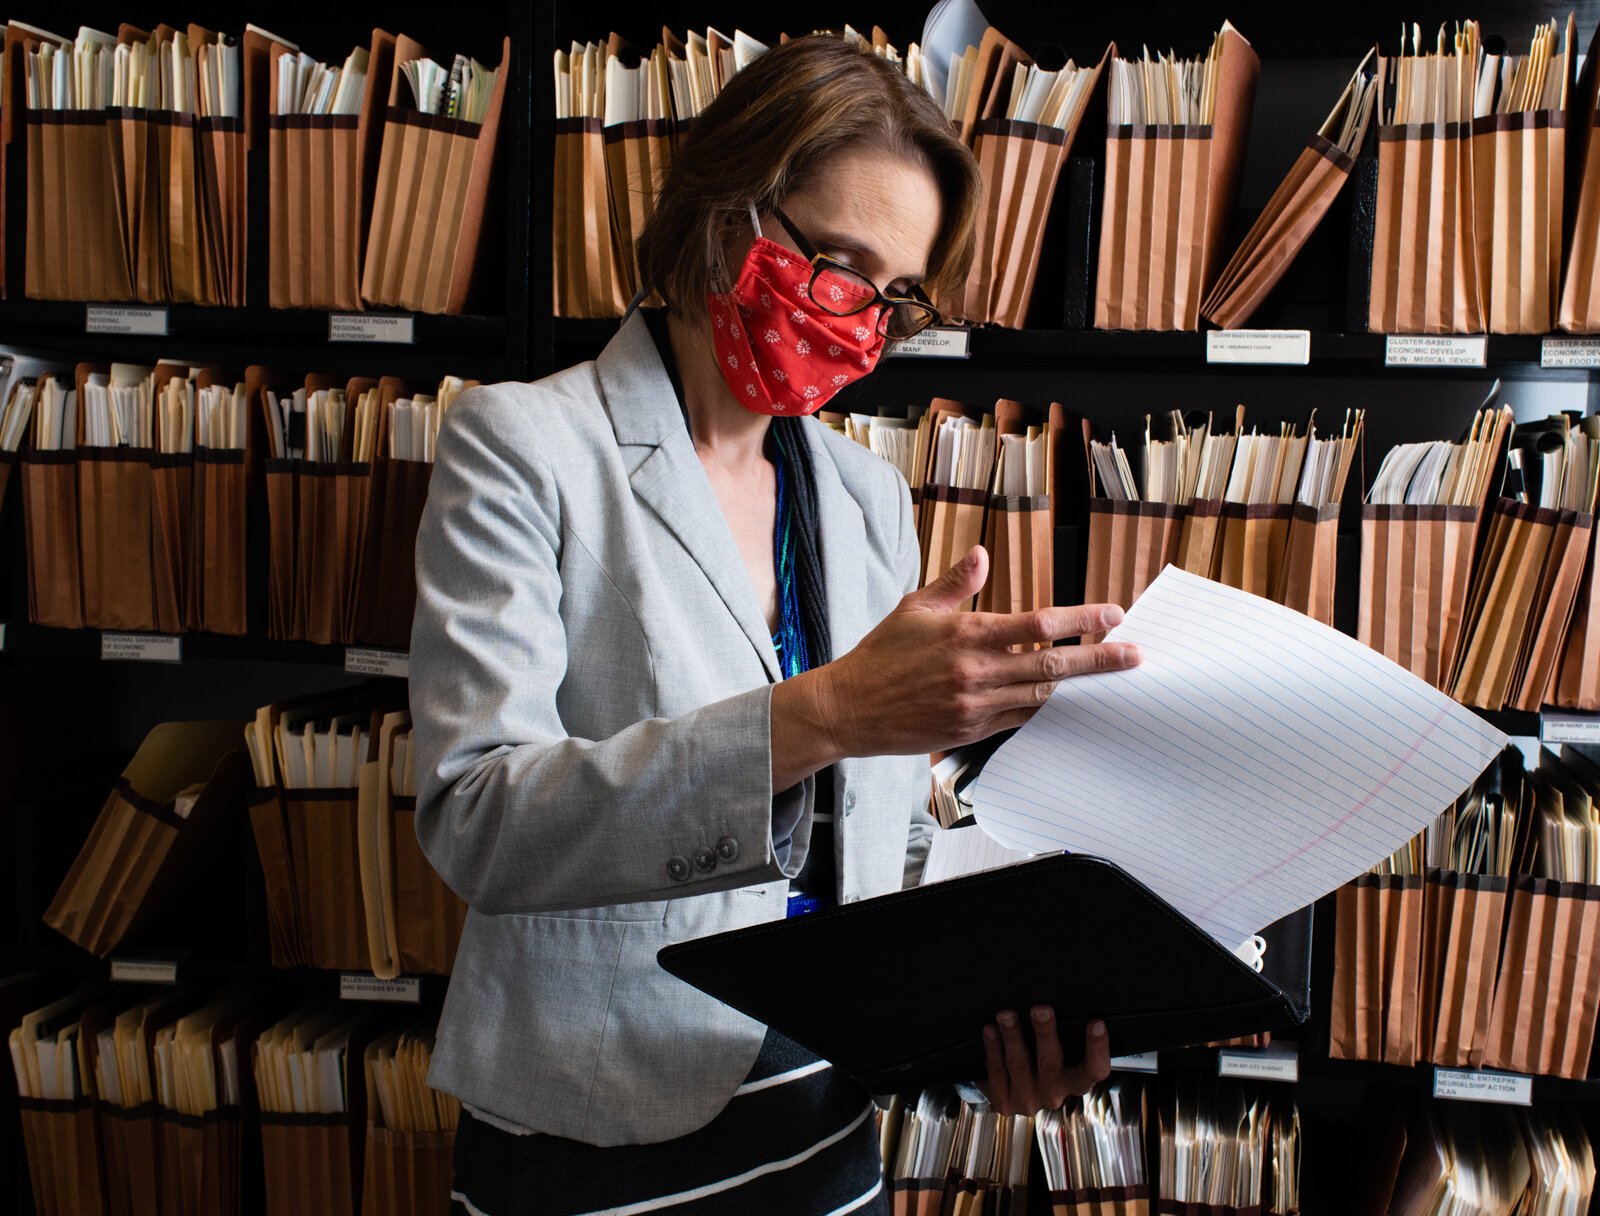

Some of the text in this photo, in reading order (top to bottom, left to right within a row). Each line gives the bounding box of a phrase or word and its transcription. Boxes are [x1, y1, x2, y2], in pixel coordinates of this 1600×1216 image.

[1389, 338, 1452, 346] CLUSTER-BASED
[1438, 1071, 1475, 1080] REGIONAL
[1437, 1080, 1516, 1092] NEURIALSHIP ACTION
